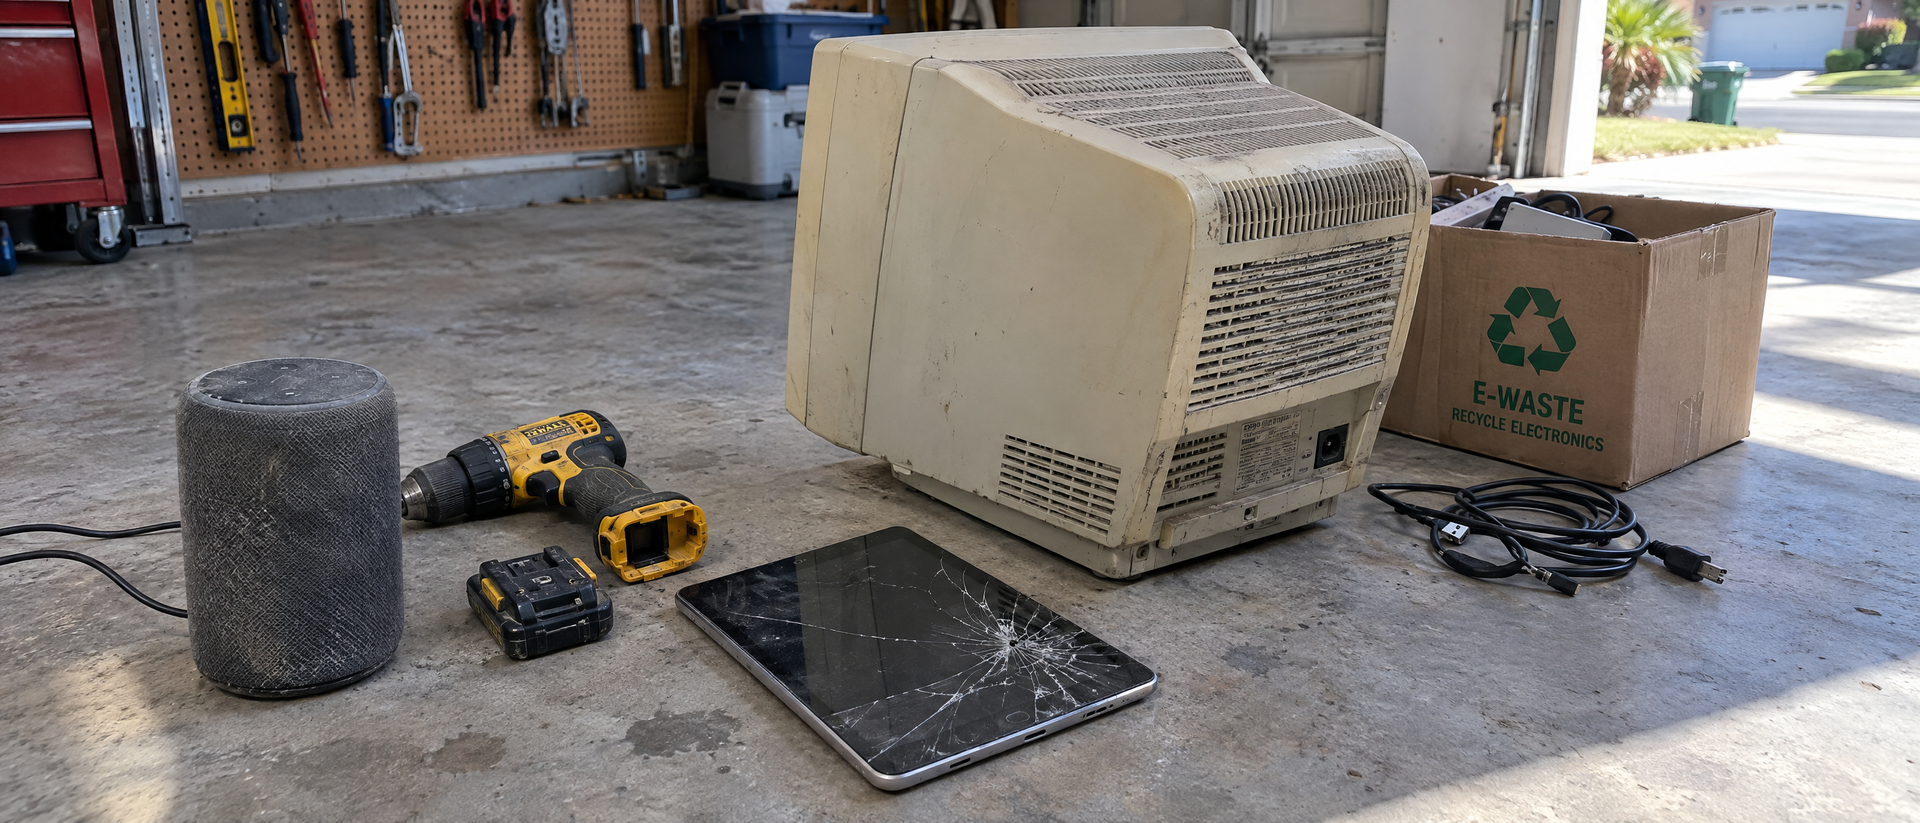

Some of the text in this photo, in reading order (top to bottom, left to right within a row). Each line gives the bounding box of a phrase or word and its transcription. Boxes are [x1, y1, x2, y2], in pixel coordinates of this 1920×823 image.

[1473, 380, 1585, 425] E-WASTE
[1452, 407, 1605, 452] RECYCLE ELECTRONICS
